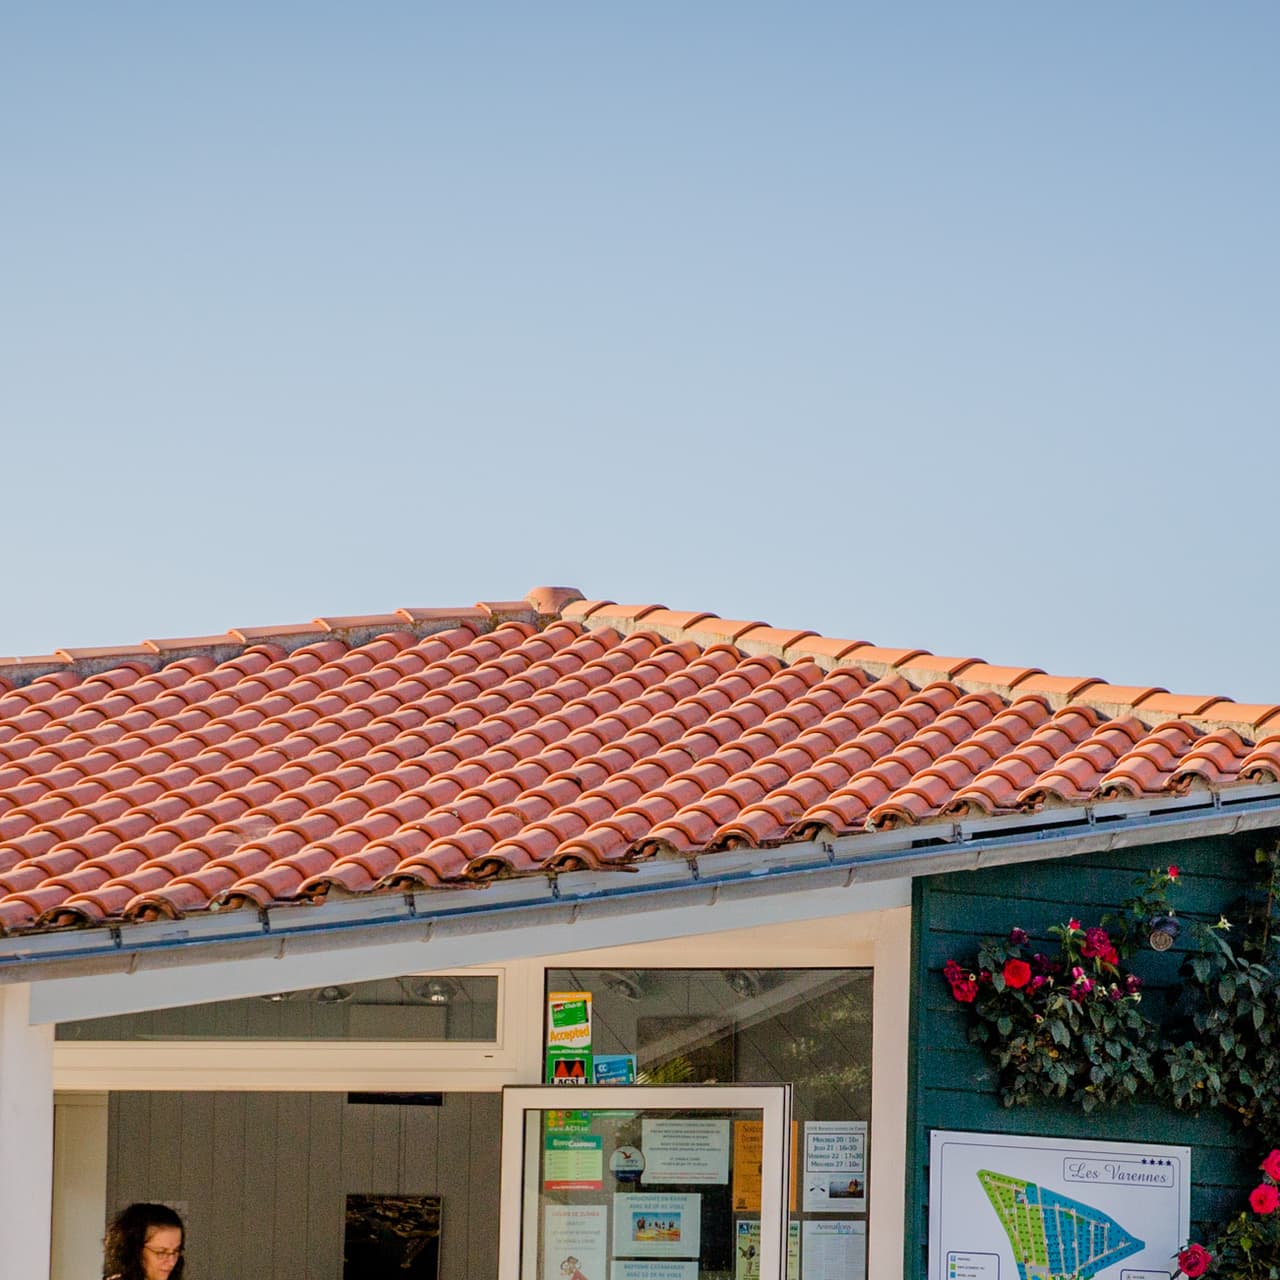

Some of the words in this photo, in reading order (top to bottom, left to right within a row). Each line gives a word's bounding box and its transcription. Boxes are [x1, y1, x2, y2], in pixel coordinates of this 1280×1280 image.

[550, 1024, 589, 1042] Accepted
[1068, 1162, 1099, 1179] Les
[1104, 1164, 1168, 1183] Varennes
